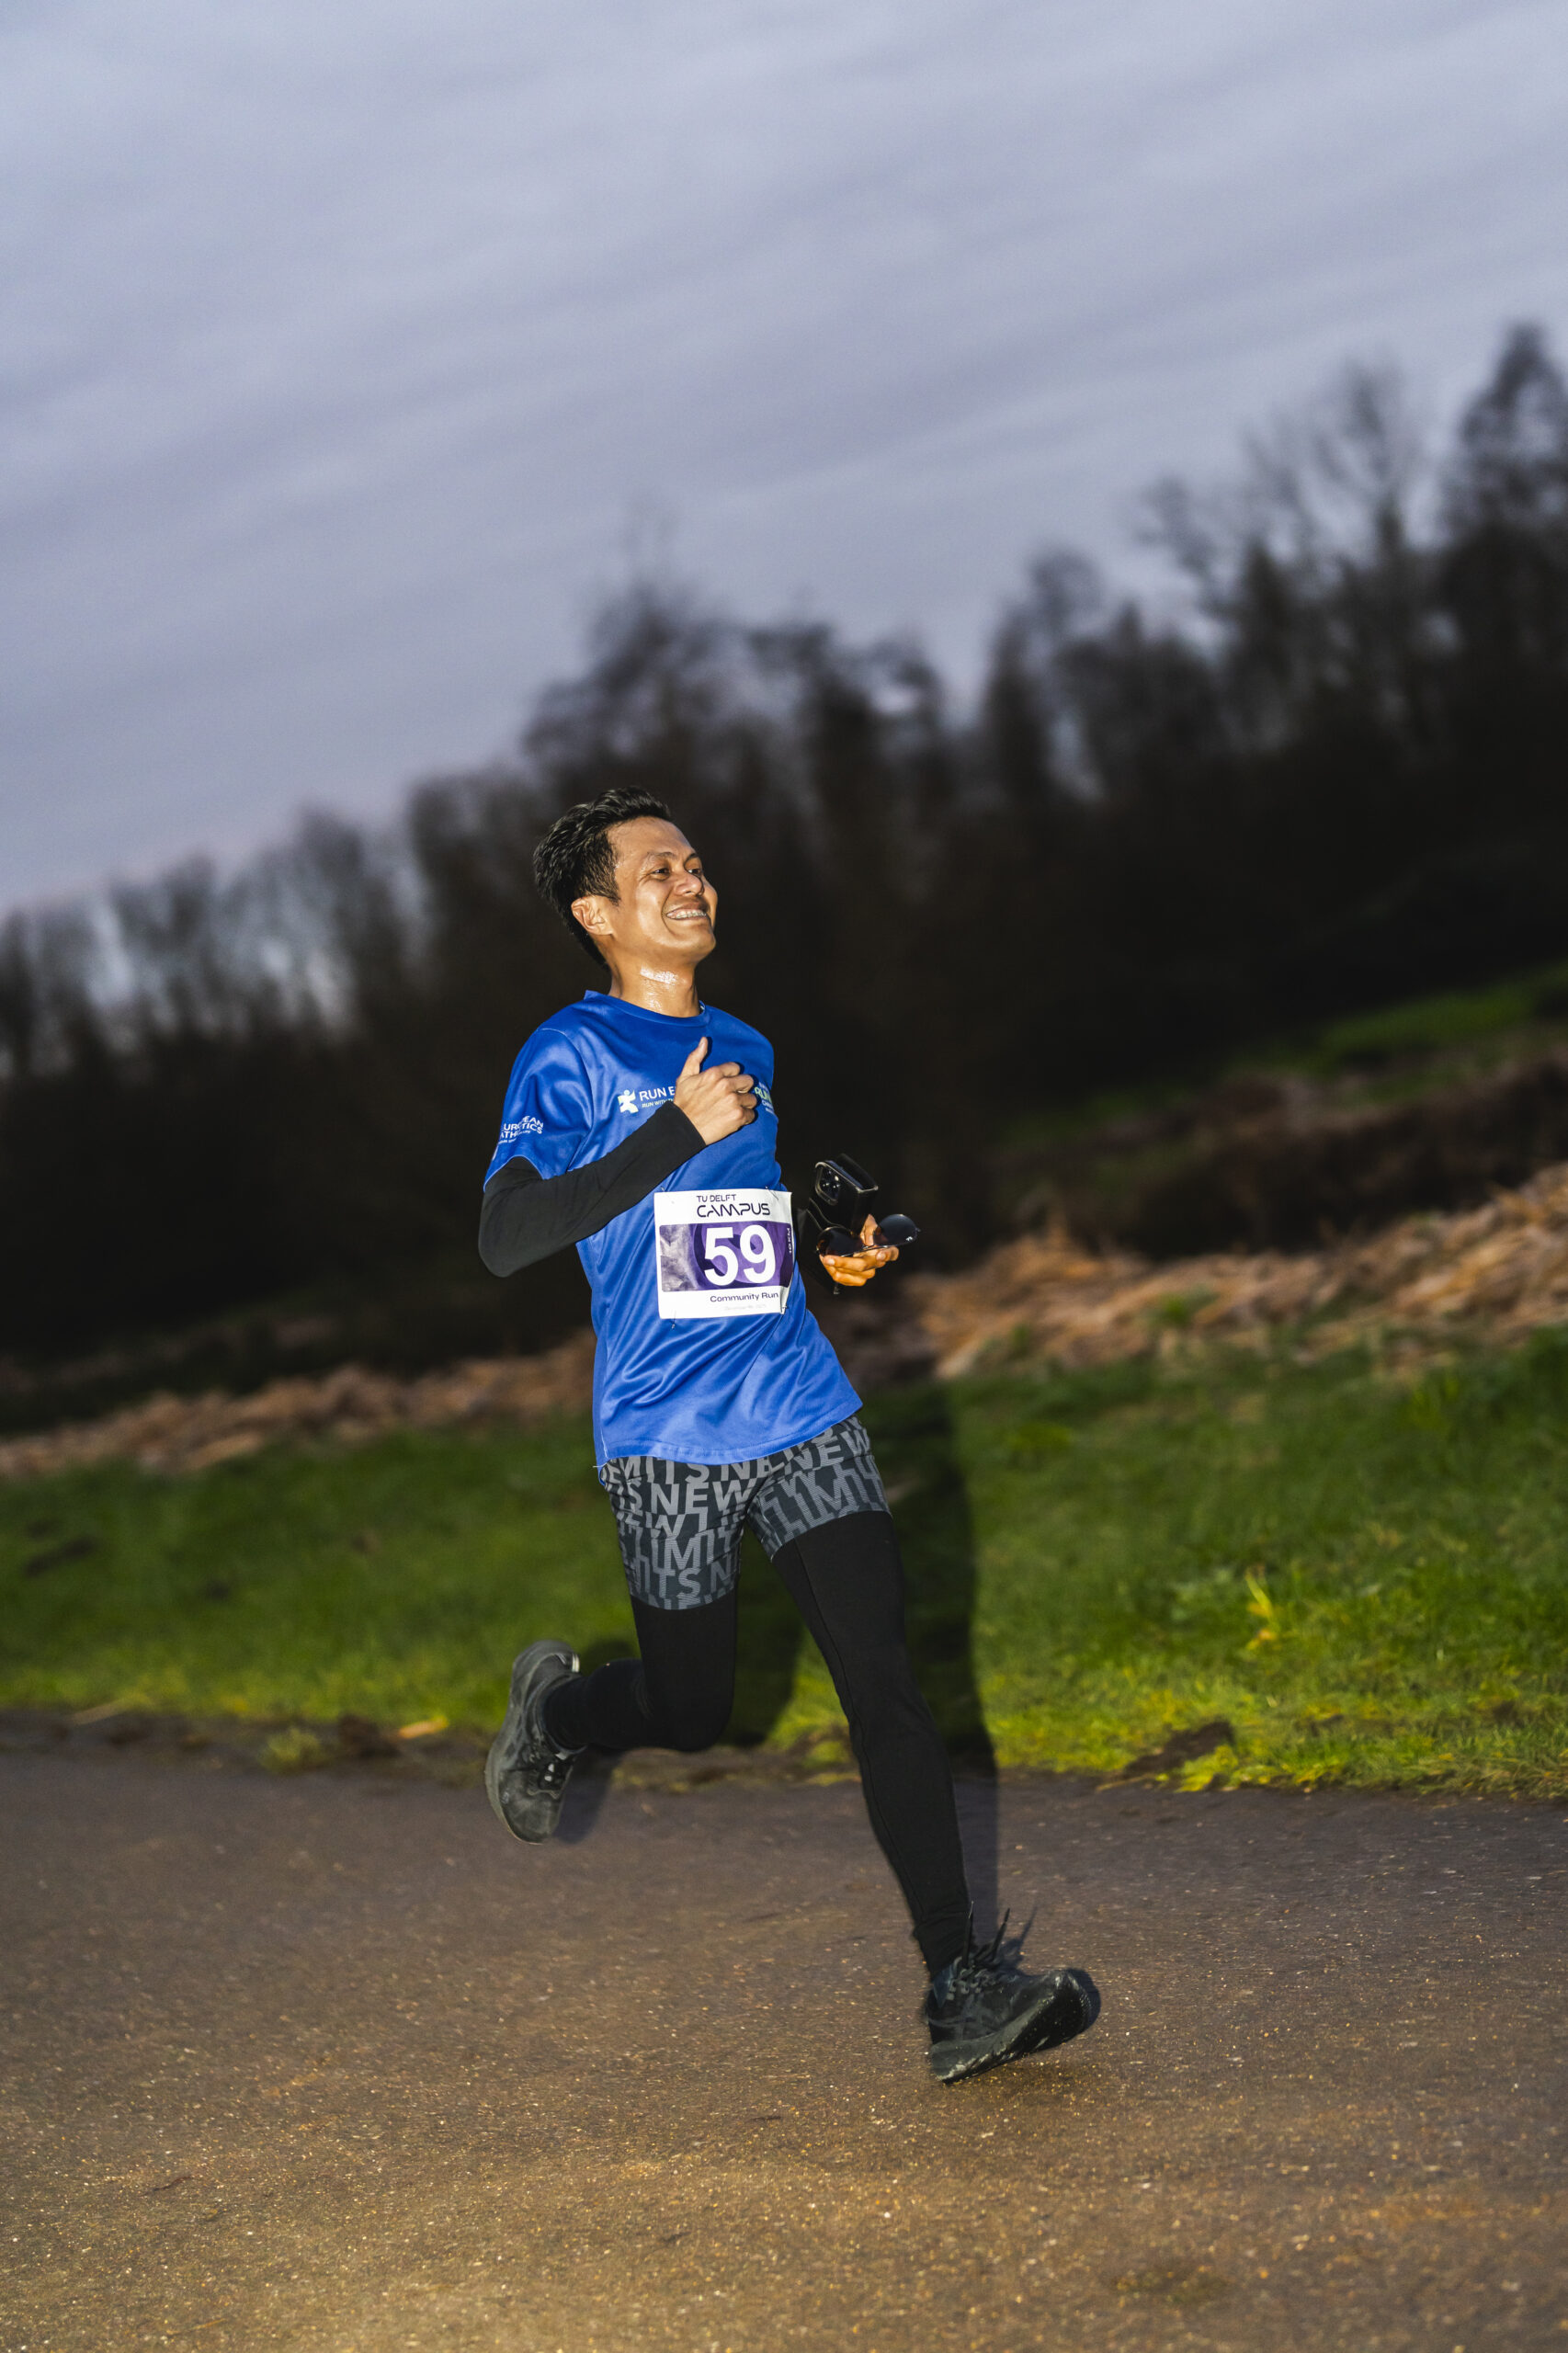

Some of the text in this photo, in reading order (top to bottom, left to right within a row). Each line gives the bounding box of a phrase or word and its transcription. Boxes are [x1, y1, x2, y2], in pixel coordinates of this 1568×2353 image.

[639, 1086, 676, 1101] RUN E
[710, 1194, 737, 1202] DELFT
[697, 1203, 770, 1217] CAMPUS
[704, 1224, 776, 1286] 59
[710, 1293, 760, 1302] Community
[651, 1478, 756, 1516] NEW
